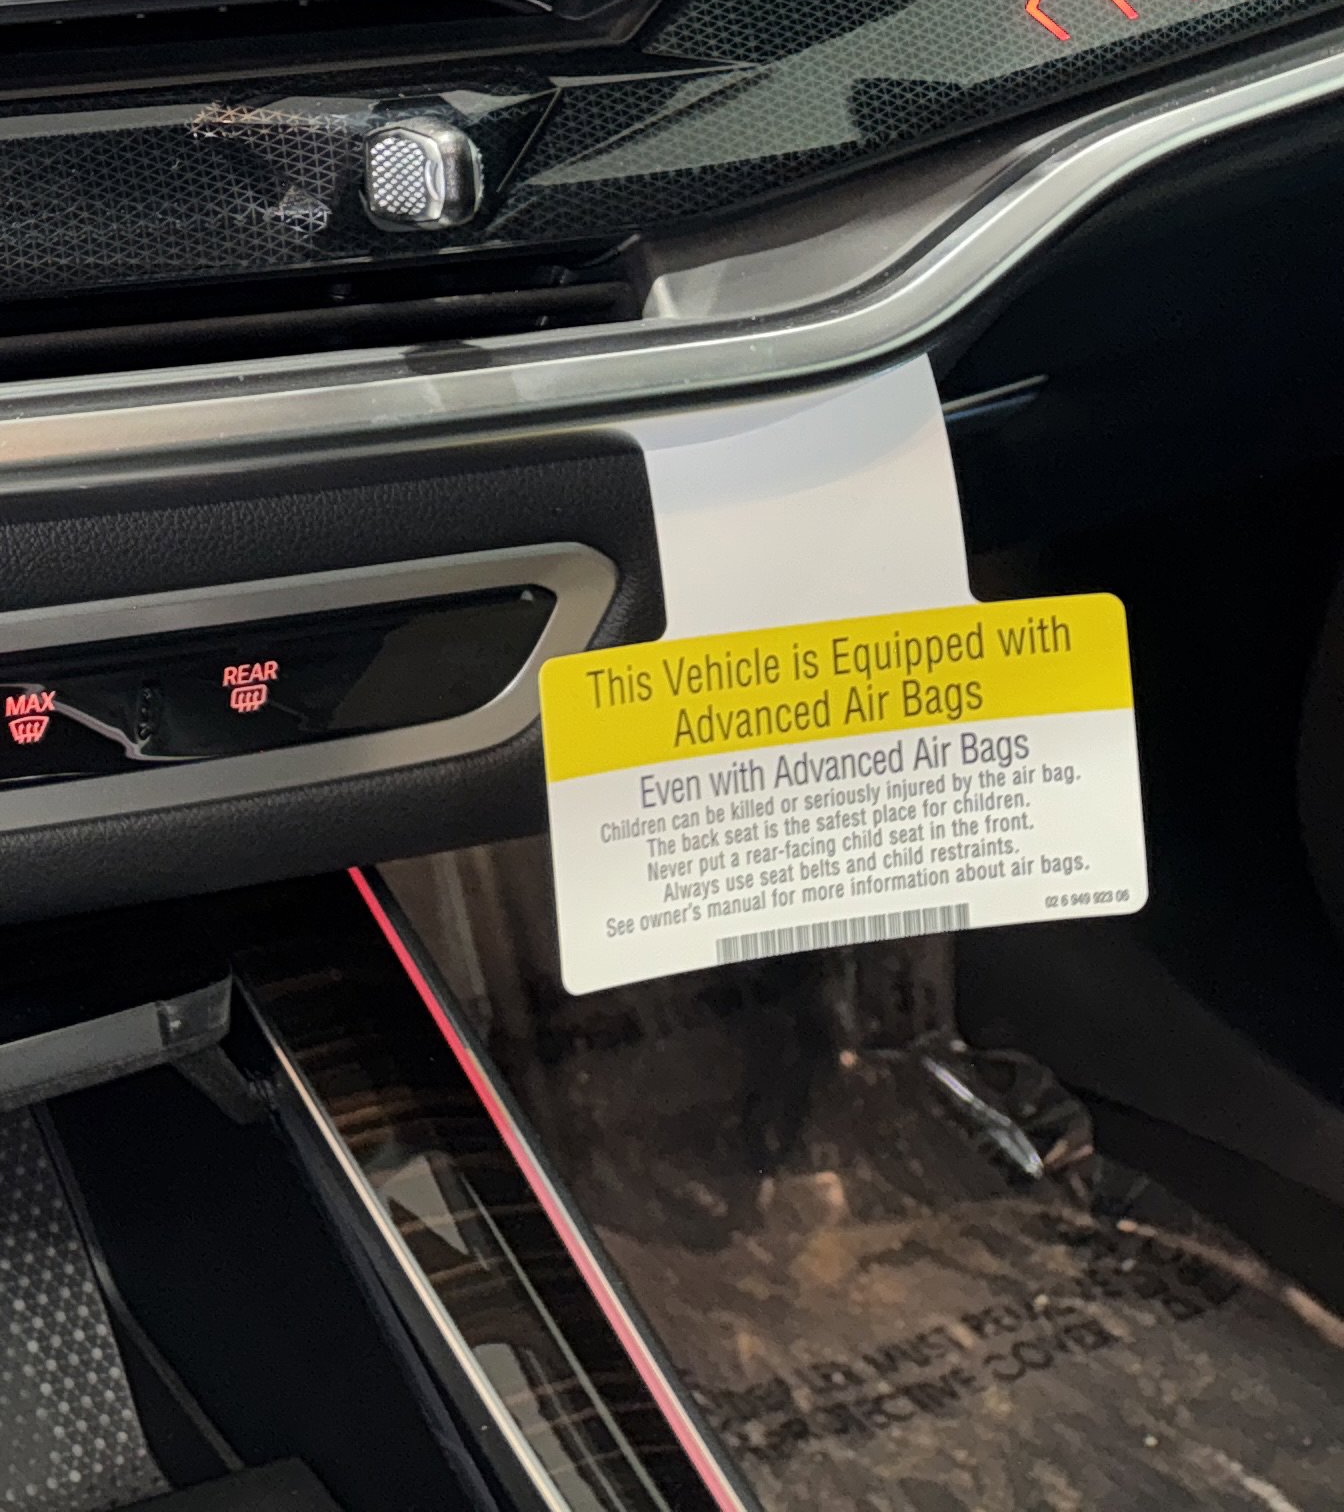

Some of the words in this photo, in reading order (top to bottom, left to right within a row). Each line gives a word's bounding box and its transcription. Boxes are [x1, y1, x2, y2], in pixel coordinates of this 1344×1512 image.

[223, 661, 278, 686] REAR
[586, 665, 653, 708] This
[662, 648, 780, 696] Vehicle
[793, 643, 819, 680] is
[832, 622, 984, 680] Equipped
[997, 615, 1071, 657] with
[5, 690, 56, 716] MAX
[674, 689, 830, 747] Advanced
[844, 684, 889, 724] Air
[903, 679, 983, 720] Bags
[600, 817, 666, 843] Children
[672, 810, 700, 831] can
[706, 805, 725, 824] be
[731, 797, 774, 821] killed
[781, 795, 799, 813] or
[804, 783, 880, 810] seriously
[886, 775, 945, 802] injured
[952, 772, 972, 793] by
[979, 768, 1006, 789] the
[1012, 767, 1035, 785] air
[1042, 763, 1081, 784] bag.
[640, 774, 701, 808] Even
[709, 759, 765, 797] with
[774, 741, 903, 789] Advanced
[913, 736, 951, 771] Air
[961, 731, 1030, 767] Bags
[647, 837, 676, 858] The
[682, 829, 720, 853] back
[725, 822, 759, 846] seat
[764, 819, 779, 839] is
[784, 815, 810, 835] the
[816, 809, 867, 831] safest
[873, 804, 916, 828] place
[922, 798, 947, 818] for
[953, 792, 1031, 814] children.
[647, 859, 693, 881] Never
[699, 851, 726, 876] put
[730, 851, 740, 866] a
[746, 836, 836, 865] rear-facing
[842, 829, 883, 852] child
[890, 824, 924, 845] seat
[930, 820, 945, 840] in
[952, 817, 979, 837] the
[985, 812, 1034, 833] front.
[606, 917, 635, 938] See
[640, 902, 701, 931] owner's
[707, 891, 765, 918] manual
[771, 887, 795, 908] for
[802, 882, 845, 903] more
[851, 868, 949, 897] information
[955, 862, 1006, 883] about
[1011, 858, 1034, 877] air
[1040, 854, 1090, 876] bags.
[663, 877, 720, 902] Always
[726, 872, 754, 891] use
[761, 864, 794, 887] seat
[800, 858, 840, 882] belts
[846, 853, 876, 873] and
[883, 846, 924, 869] child
[930, 838, 1020, 862] restraints.
